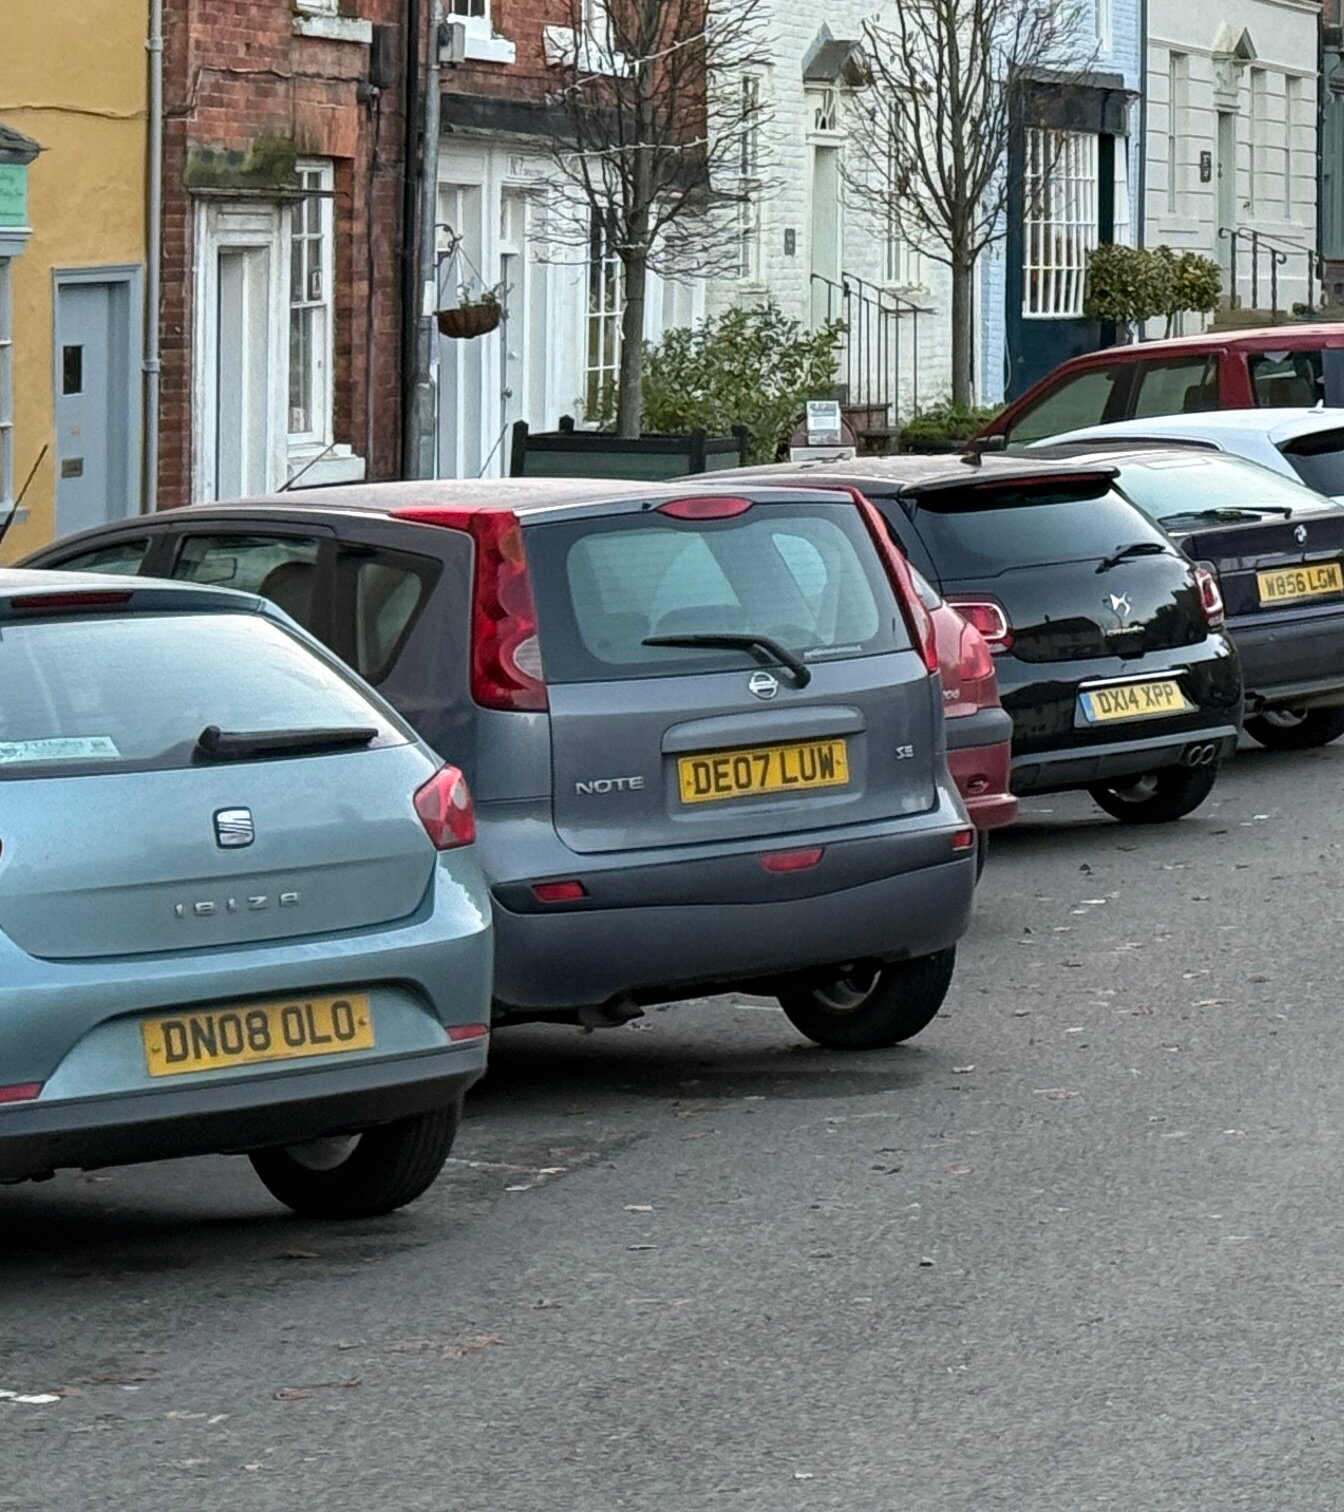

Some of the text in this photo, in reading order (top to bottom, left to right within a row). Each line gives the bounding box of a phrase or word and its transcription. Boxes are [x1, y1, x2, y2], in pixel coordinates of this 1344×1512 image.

[1265, 571, 1306, 597] W856
[1096, 684, 1174, 714] DX14 XPP
[692, 745, 834, 795] DE07 LUW
[575, 776, 645, 795] NOTE
[175, 892, 299, 916] IBIZA
[161, 1000, 356, 1064] DN08 OLO
